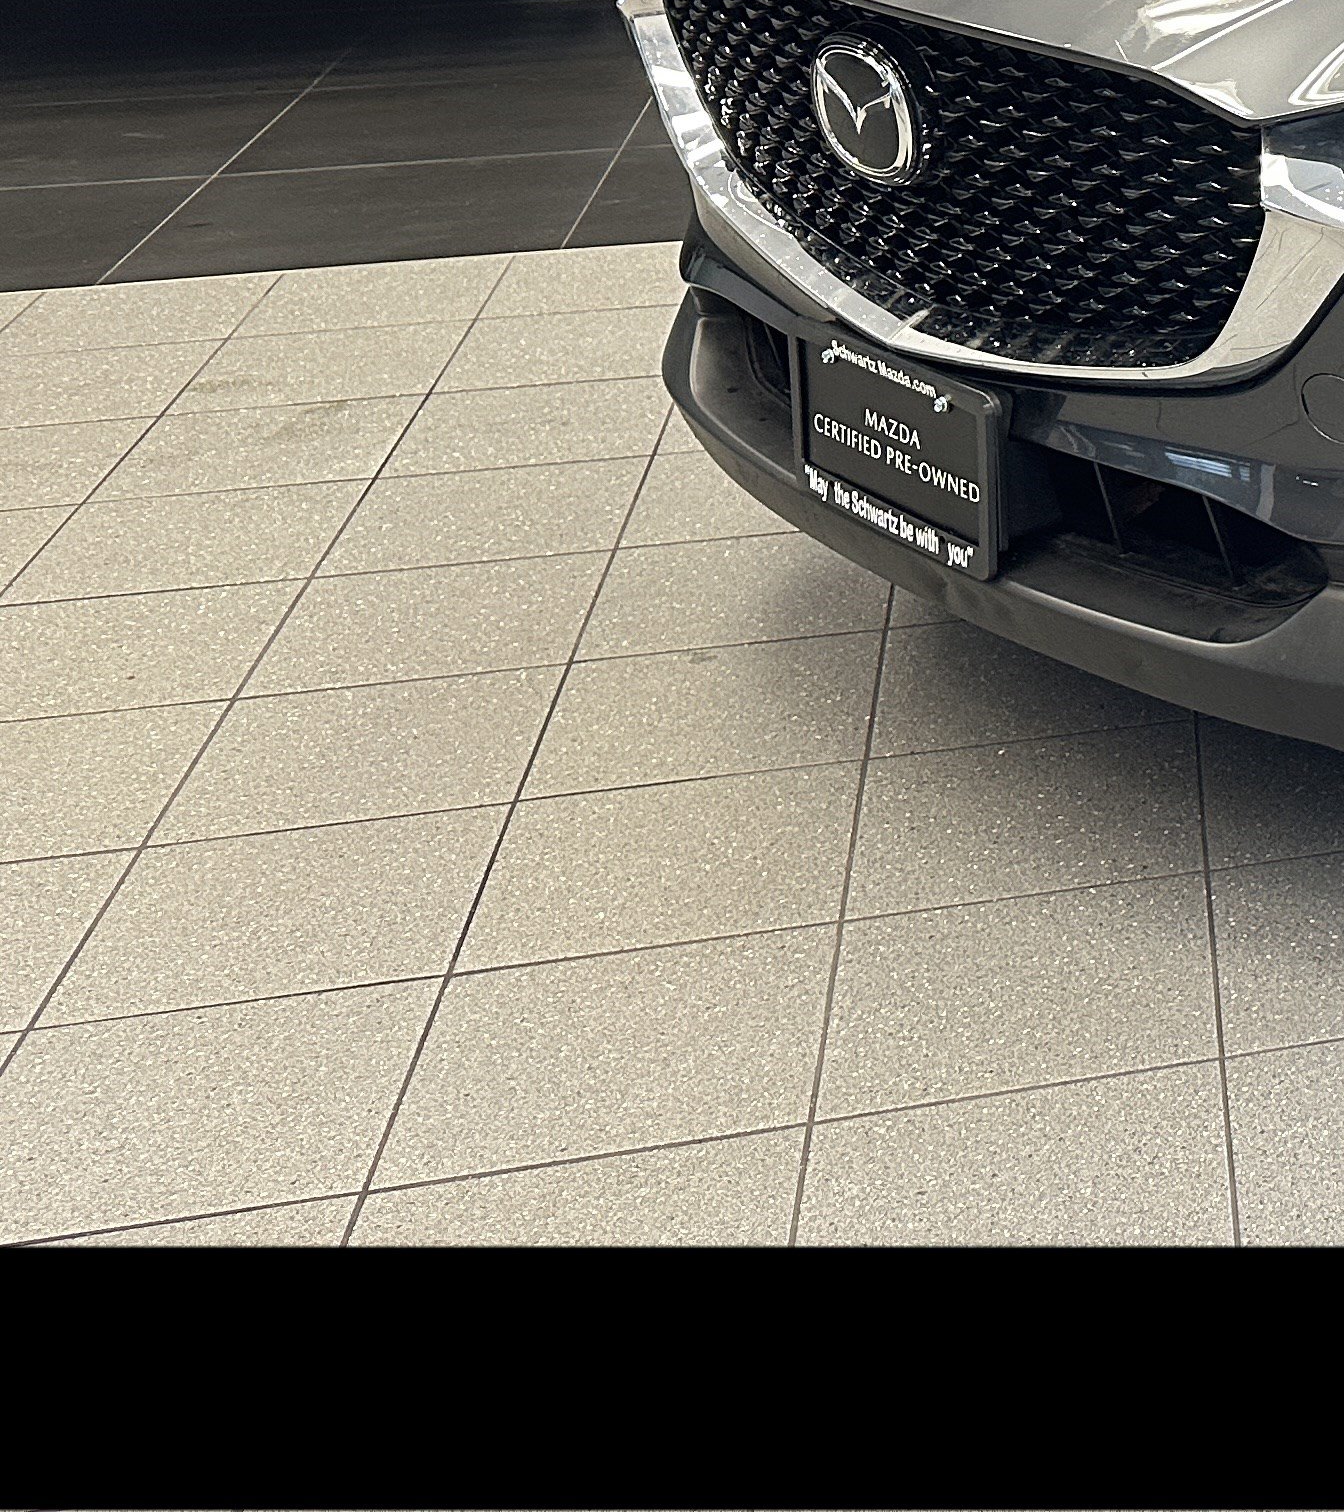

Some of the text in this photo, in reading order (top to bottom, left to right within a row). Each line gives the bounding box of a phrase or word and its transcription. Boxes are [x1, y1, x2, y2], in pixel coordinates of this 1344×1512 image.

[813, 413, 980, 503] CERTIFIED PRE-OWNED
[864, 408, 921, 450] MAZDA
[834, 481, 850, 510] the
[851, 491, 899, 534] Schwartz
[899, 515, 914, 541] be
[916, 527, 939, 555] with
